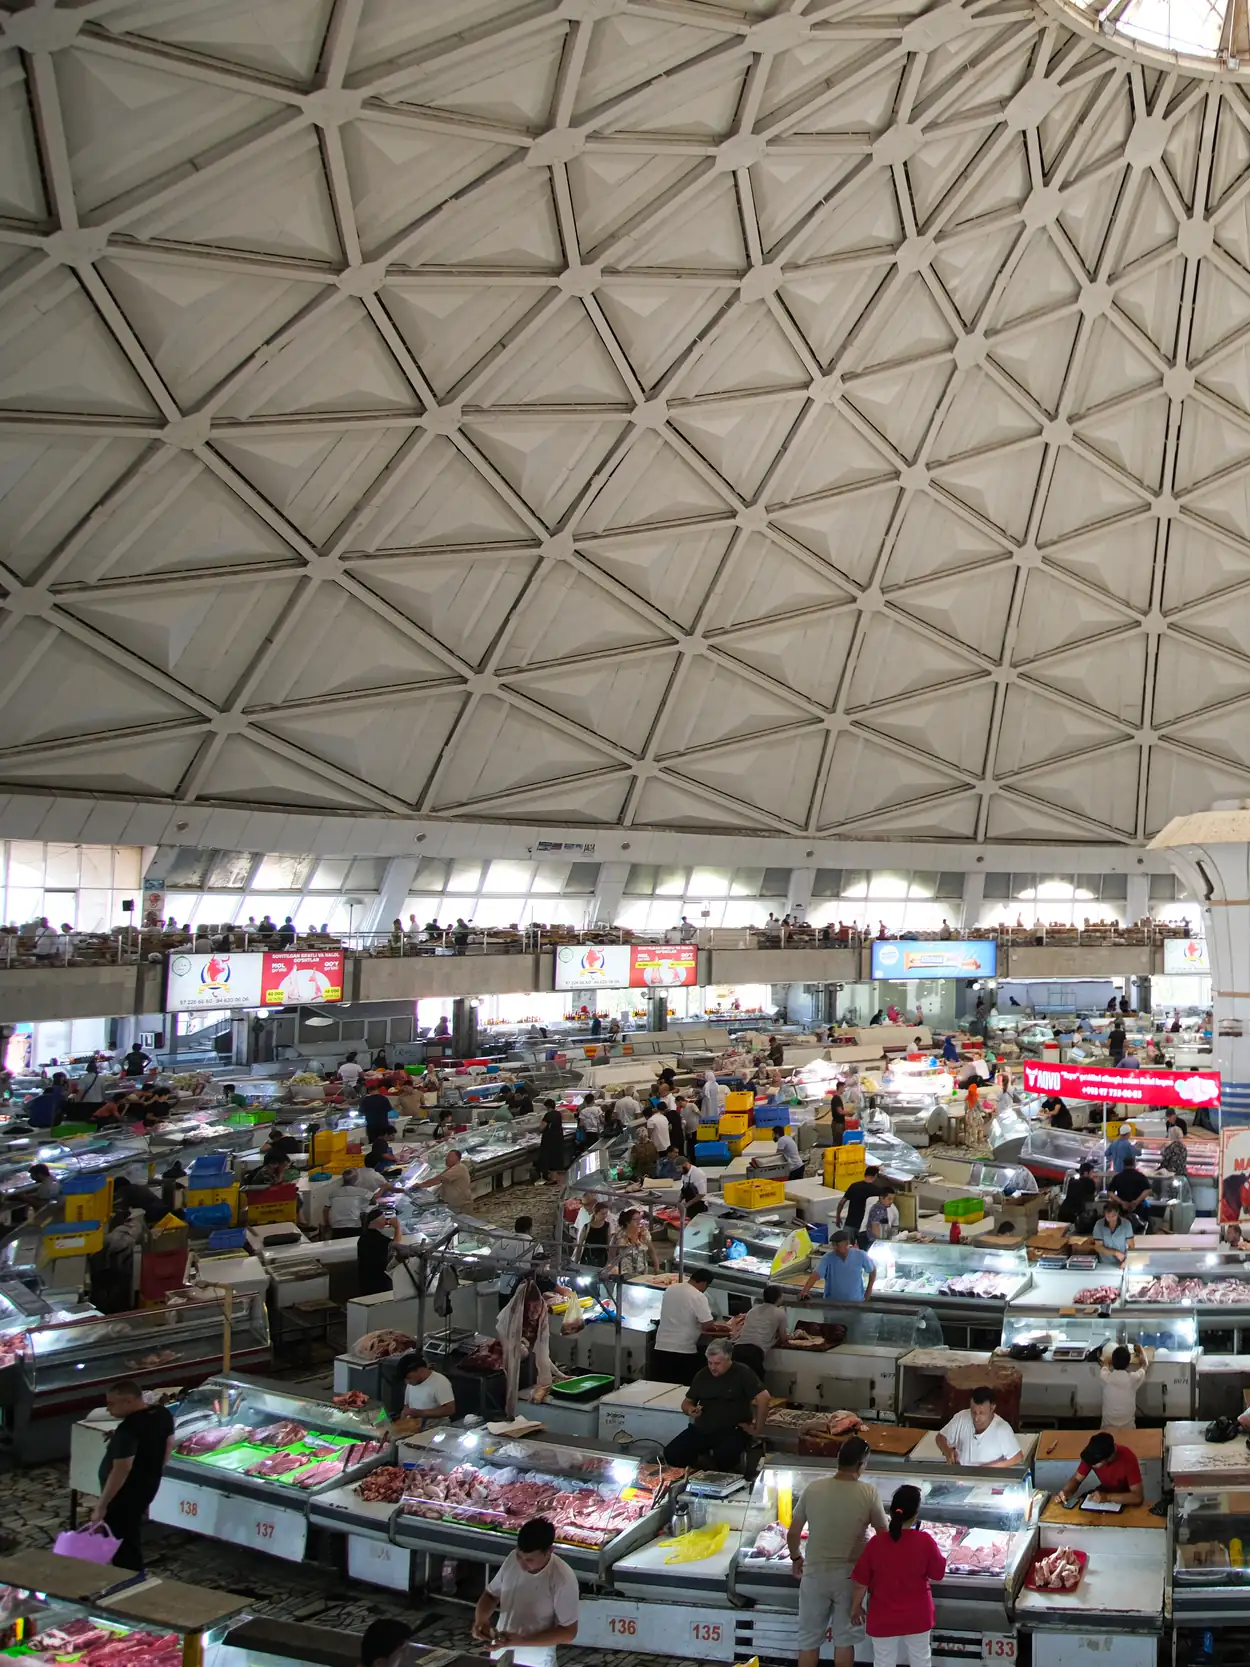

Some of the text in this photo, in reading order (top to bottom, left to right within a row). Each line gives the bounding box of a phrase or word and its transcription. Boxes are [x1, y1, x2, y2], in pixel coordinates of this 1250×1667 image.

[180, 1500, 198, 1517] 138
[255, 1522, 275, 1540] 137
[608, 1618, 637, 1636] 136
[692, 1624, 721, 1642] 135
[985, 1639, 1015, 1658] 133
